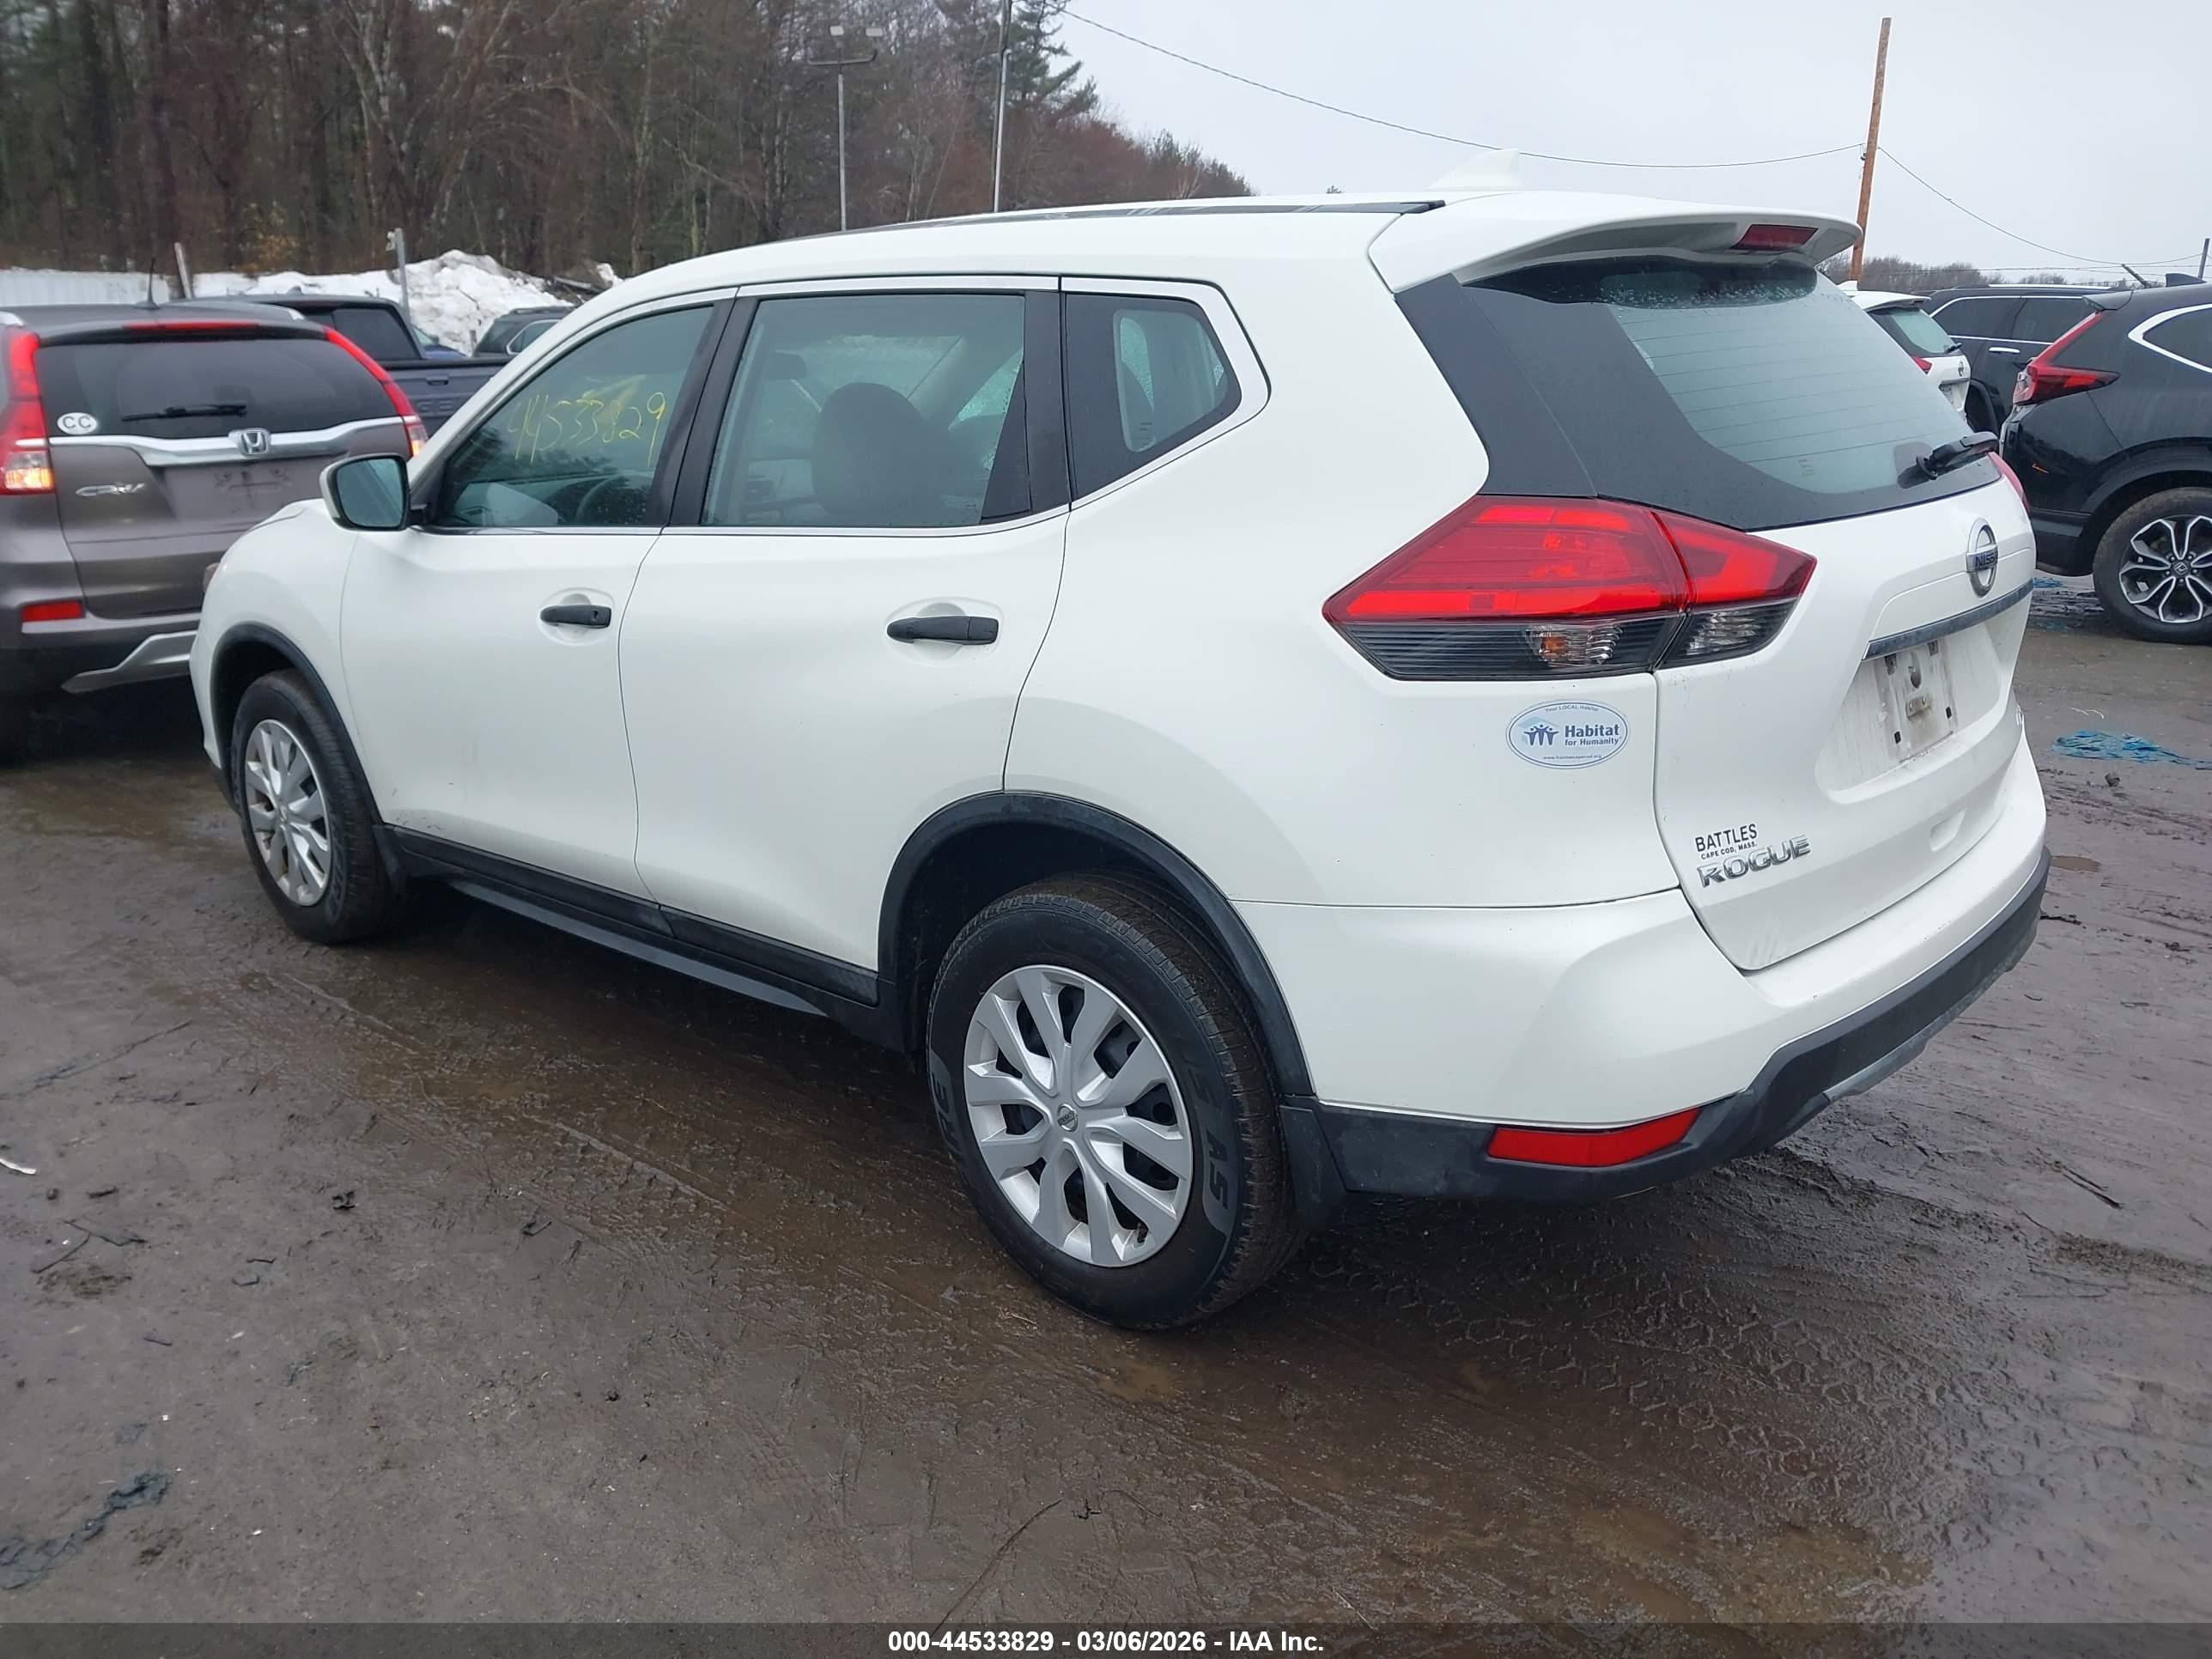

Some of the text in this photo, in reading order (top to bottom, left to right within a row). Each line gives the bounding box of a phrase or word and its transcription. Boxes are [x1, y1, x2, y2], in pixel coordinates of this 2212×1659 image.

[63, 416, 92, 429] CC
[507, 392, 666, 468] 44533829
[1565, 724, 1620, 738] Habitat
[1565, 737, 1620, 747] for Humanity
[1694, 823, 1758, 853] BATTLES
[1701, 841, 1758, 860] CAPE COD, MASS.
[1697, 834, 1812, 888] ROGUE
